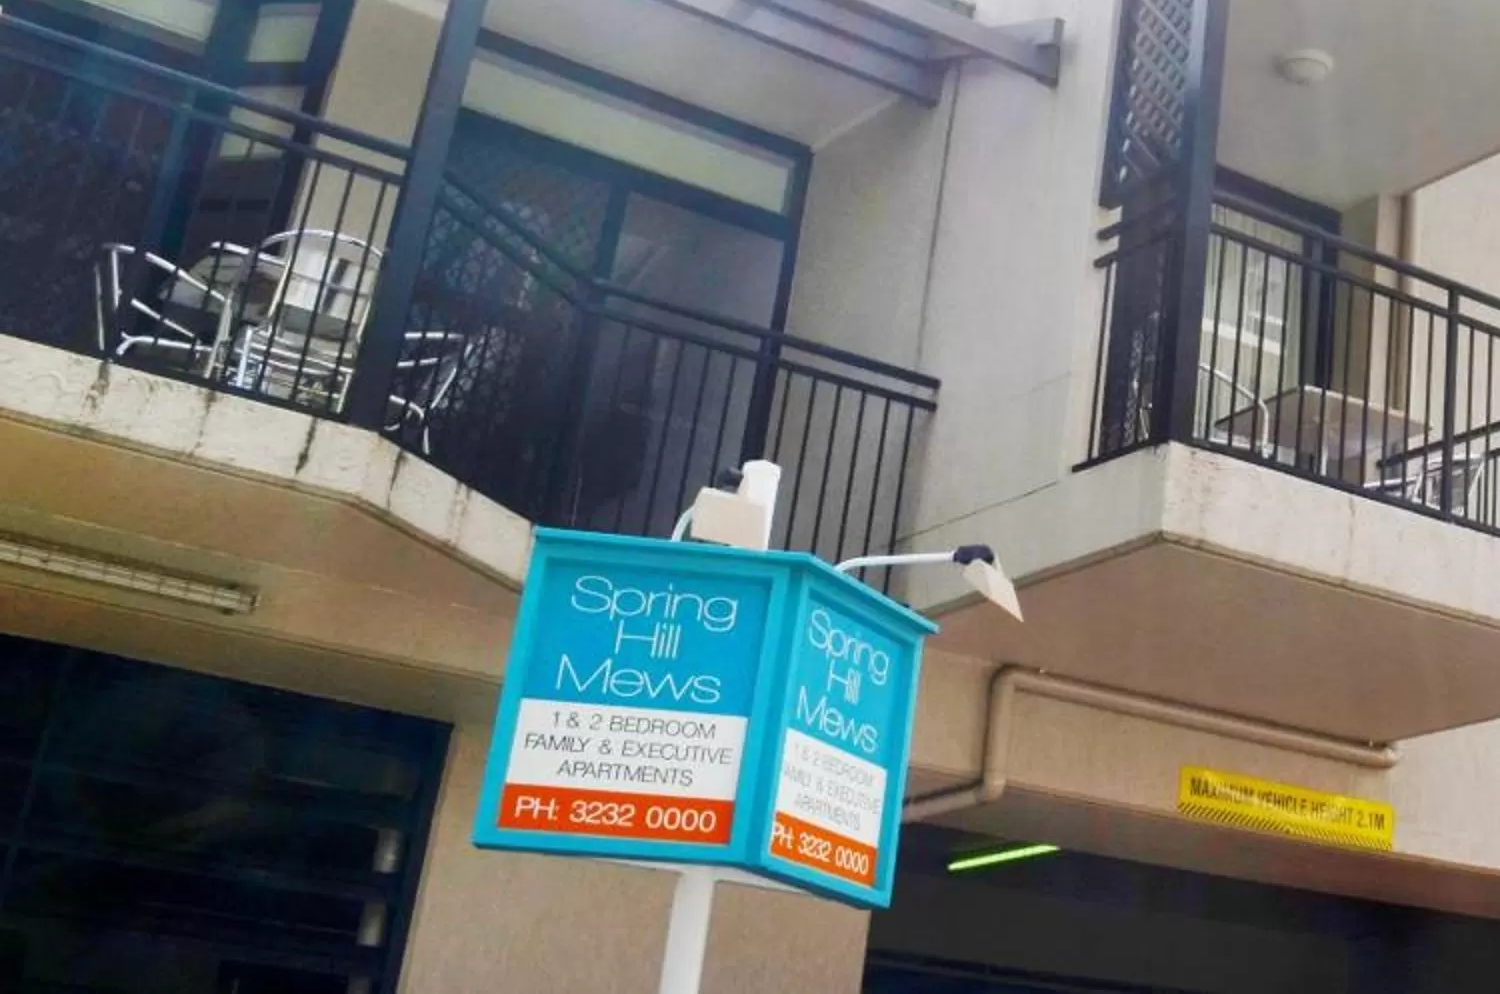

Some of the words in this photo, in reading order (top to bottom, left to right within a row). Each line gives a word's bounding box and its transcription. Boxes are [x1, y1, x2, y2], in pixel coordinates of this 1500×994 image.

[571, 575, 738, 632] Spring
[614, 619, 681, 660] Hill
[809, 609, 889, 686] Spring
[556, 653, 721, 704] Mews
[827, 659, 861, 704] Hill
[552, 712, 560, 729] 1
[566, 712, 580, 730] &
[589, 713, 602, 731] 2
[609, 715, 716, 739] BEDROOM
[796, 685, 878, 753] Mews
[524, 733, 590, 753] FAMILY
[599, 739, 612, 756] &
[621, 740, 733, 765] EXECUTIVE
[556, 759, 693, 787] APARTMENTS
[514, 795, 560, 821] PH:
[569, 800, 636, 827] 3232
[645, 806, 716, 833] 0000
[1257, 789, 1307, 815] VEHICLE
[1356, 811, 1385, 831] 2.1M
[798, 832, 832, 863] 3232
[835, 846, 869, 875] 0000
